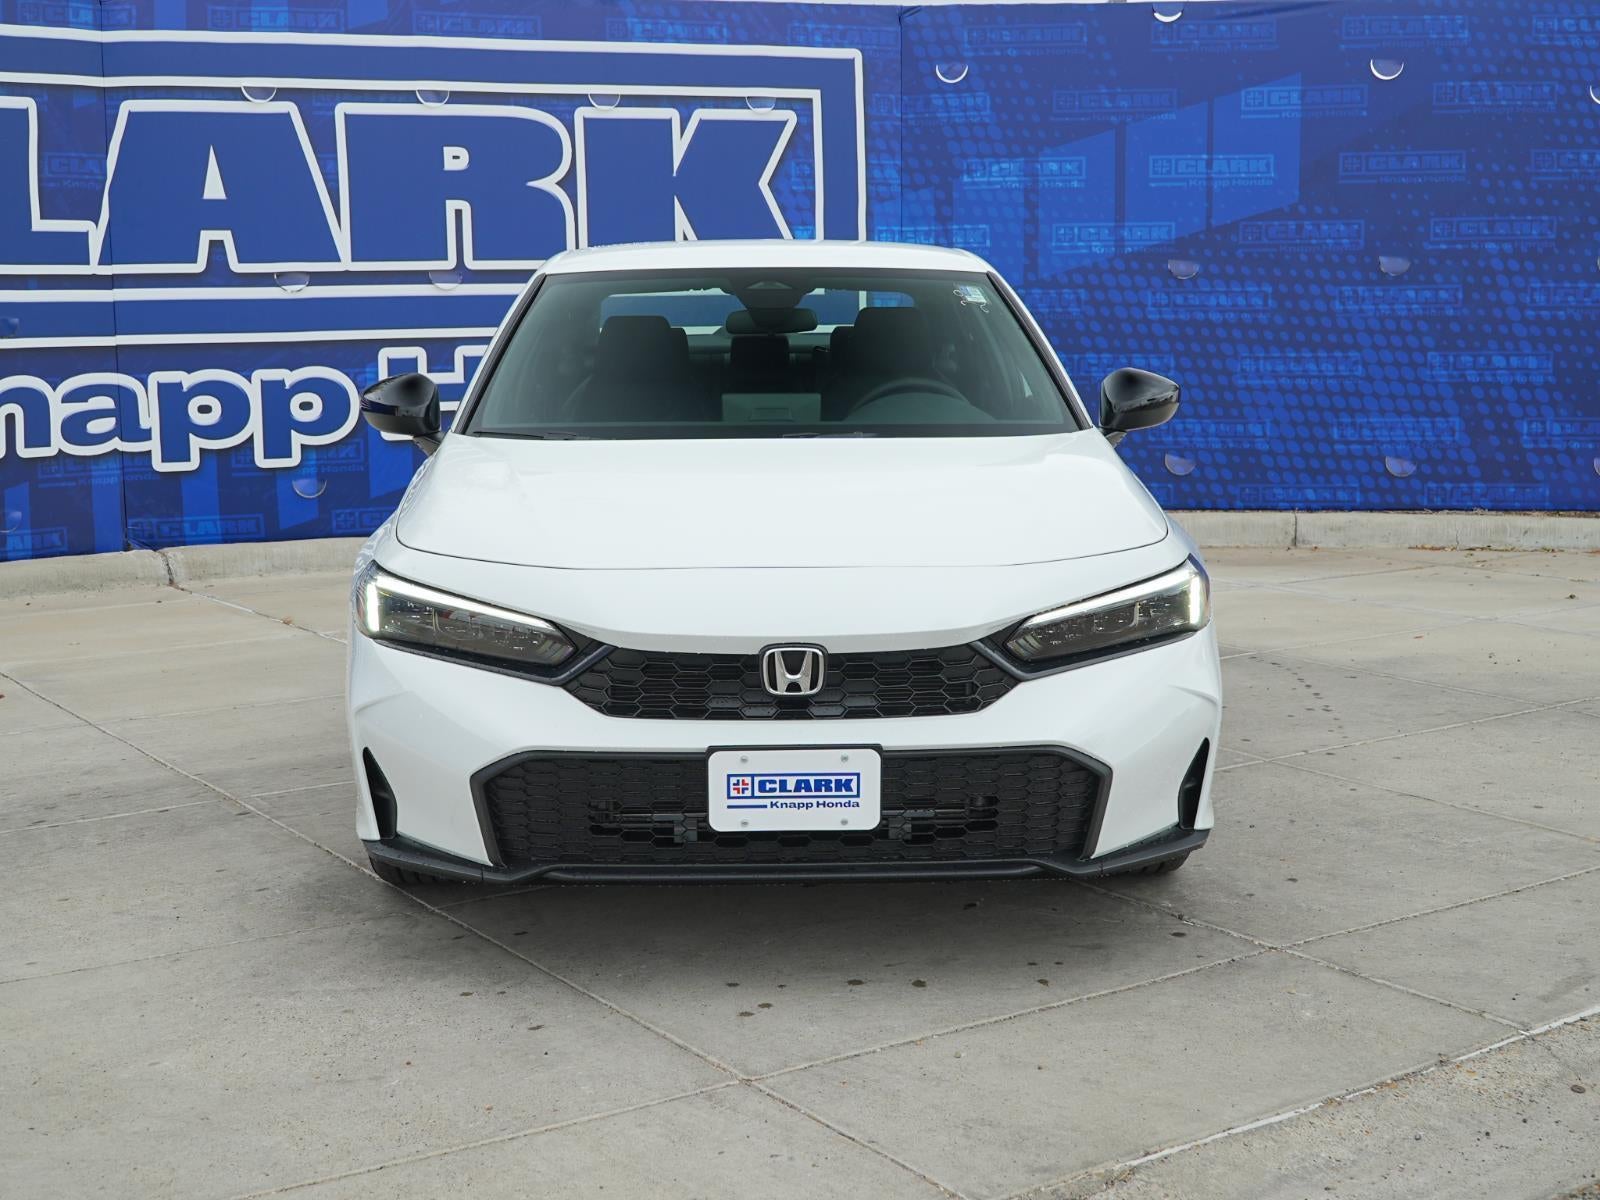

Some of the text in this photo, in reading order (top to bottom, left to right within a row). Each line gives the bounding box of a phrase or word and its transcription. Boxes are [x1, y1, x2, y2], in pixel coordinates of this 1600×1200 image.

[1178, 158, 1267, 174] CLARK
[1233, 177, 1273, 187] Honda
[758, 778, 854, 793] CLARK
[770, 800, 860, 810] Knapp Honda
